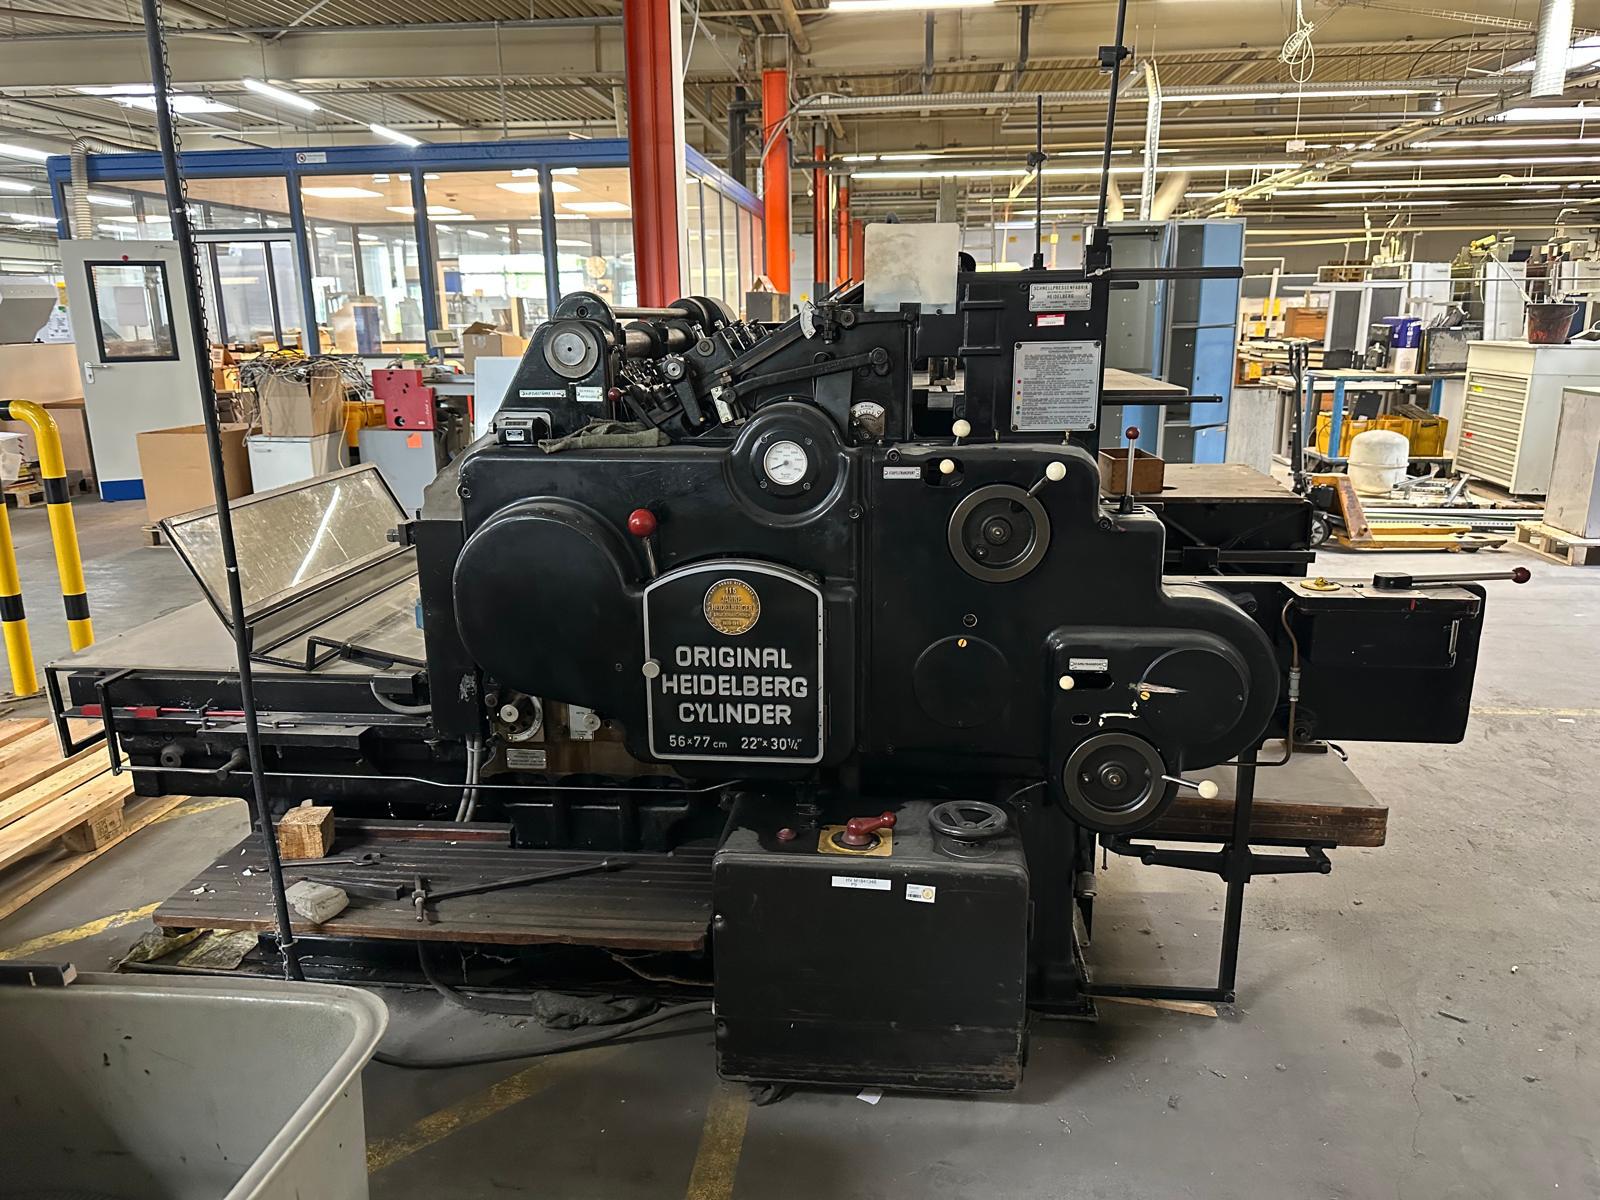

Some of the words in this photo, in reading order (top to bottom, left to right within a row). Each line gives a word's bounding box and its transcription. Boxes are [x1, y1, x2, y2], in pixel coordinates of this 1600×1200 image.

[675, 645, 792, 669] ORIGINAL
[661, 673, 808, 698] HEIDELBERG
[678, 702, 792, 725] CYLINDER
[713, 740, 728, 748] cm
